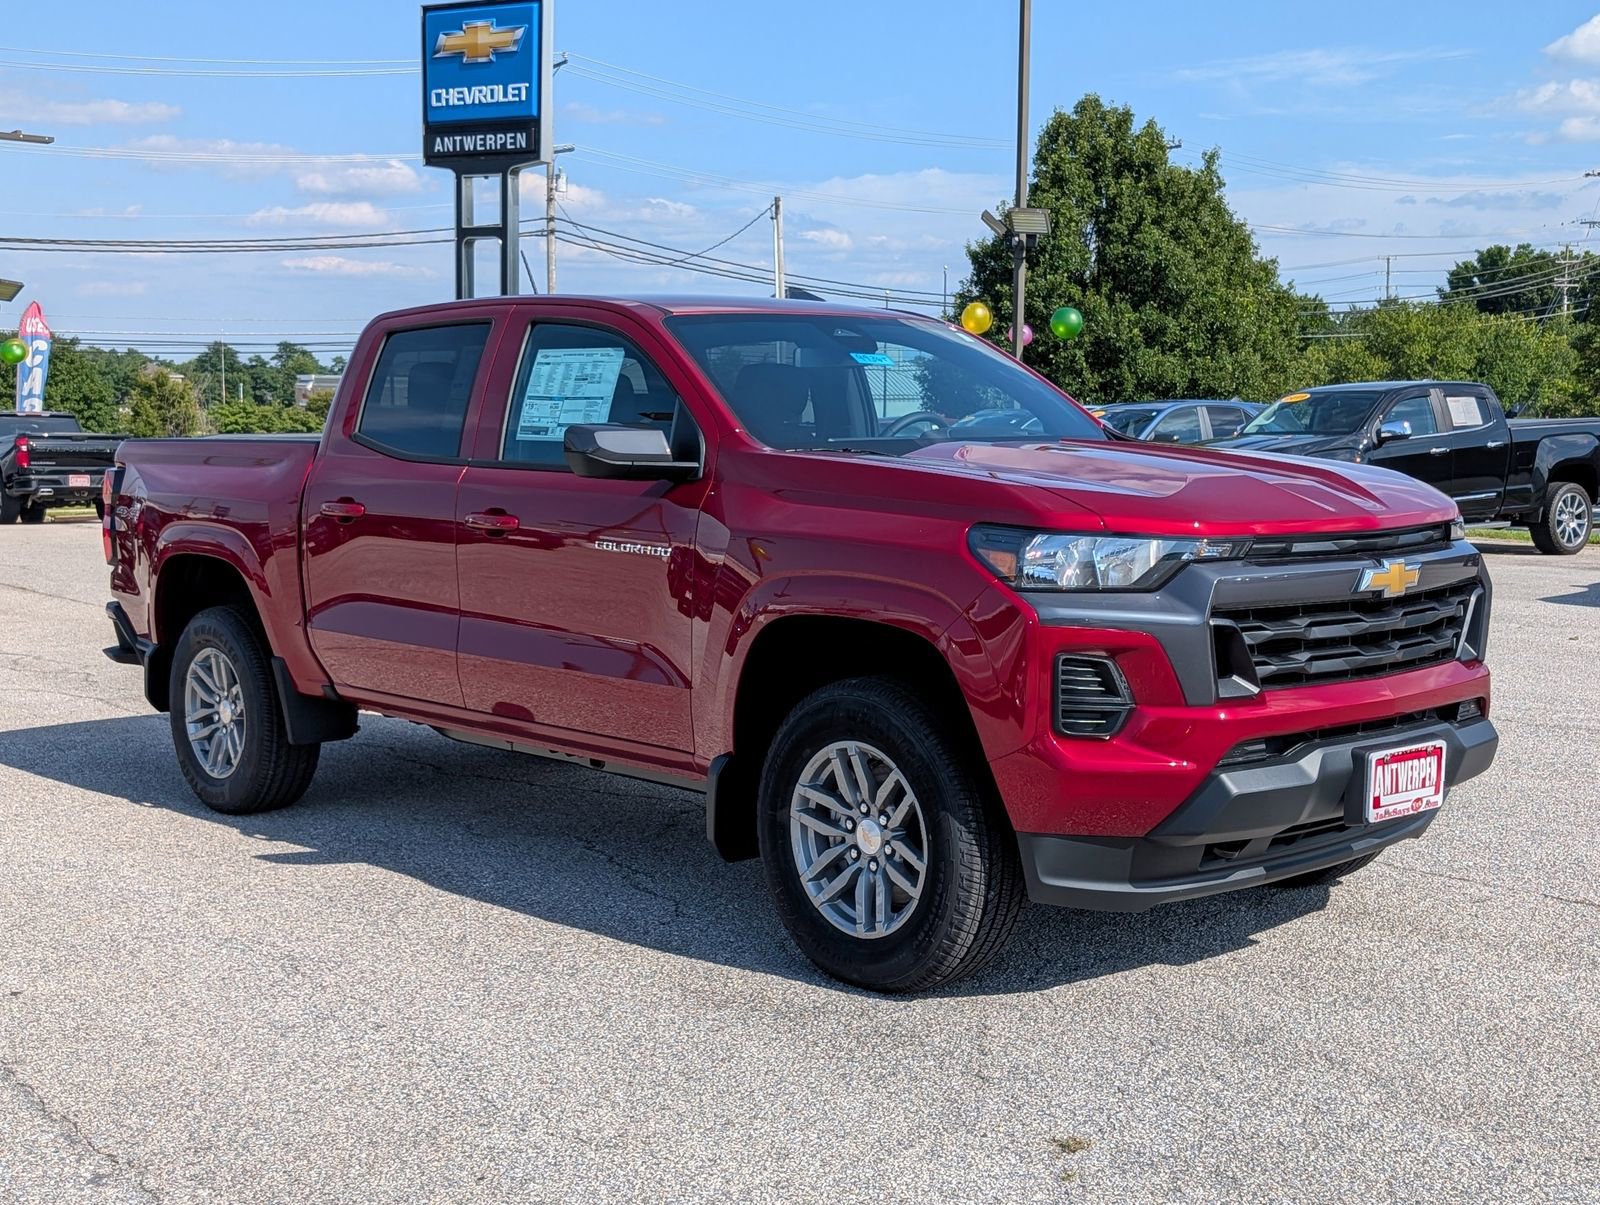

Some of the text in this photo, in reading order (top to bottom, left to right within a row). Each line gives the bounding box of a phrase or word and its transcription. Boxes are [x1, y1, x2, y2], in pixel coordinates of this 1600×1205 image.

[431, 83, 529, 107] CHEVROLET
[434, 132, 527, 153] ANTWERPEN
[594, 541, 672, 557] COLORADO
[1374, 755, 1438, 797] ANTWERPEN
